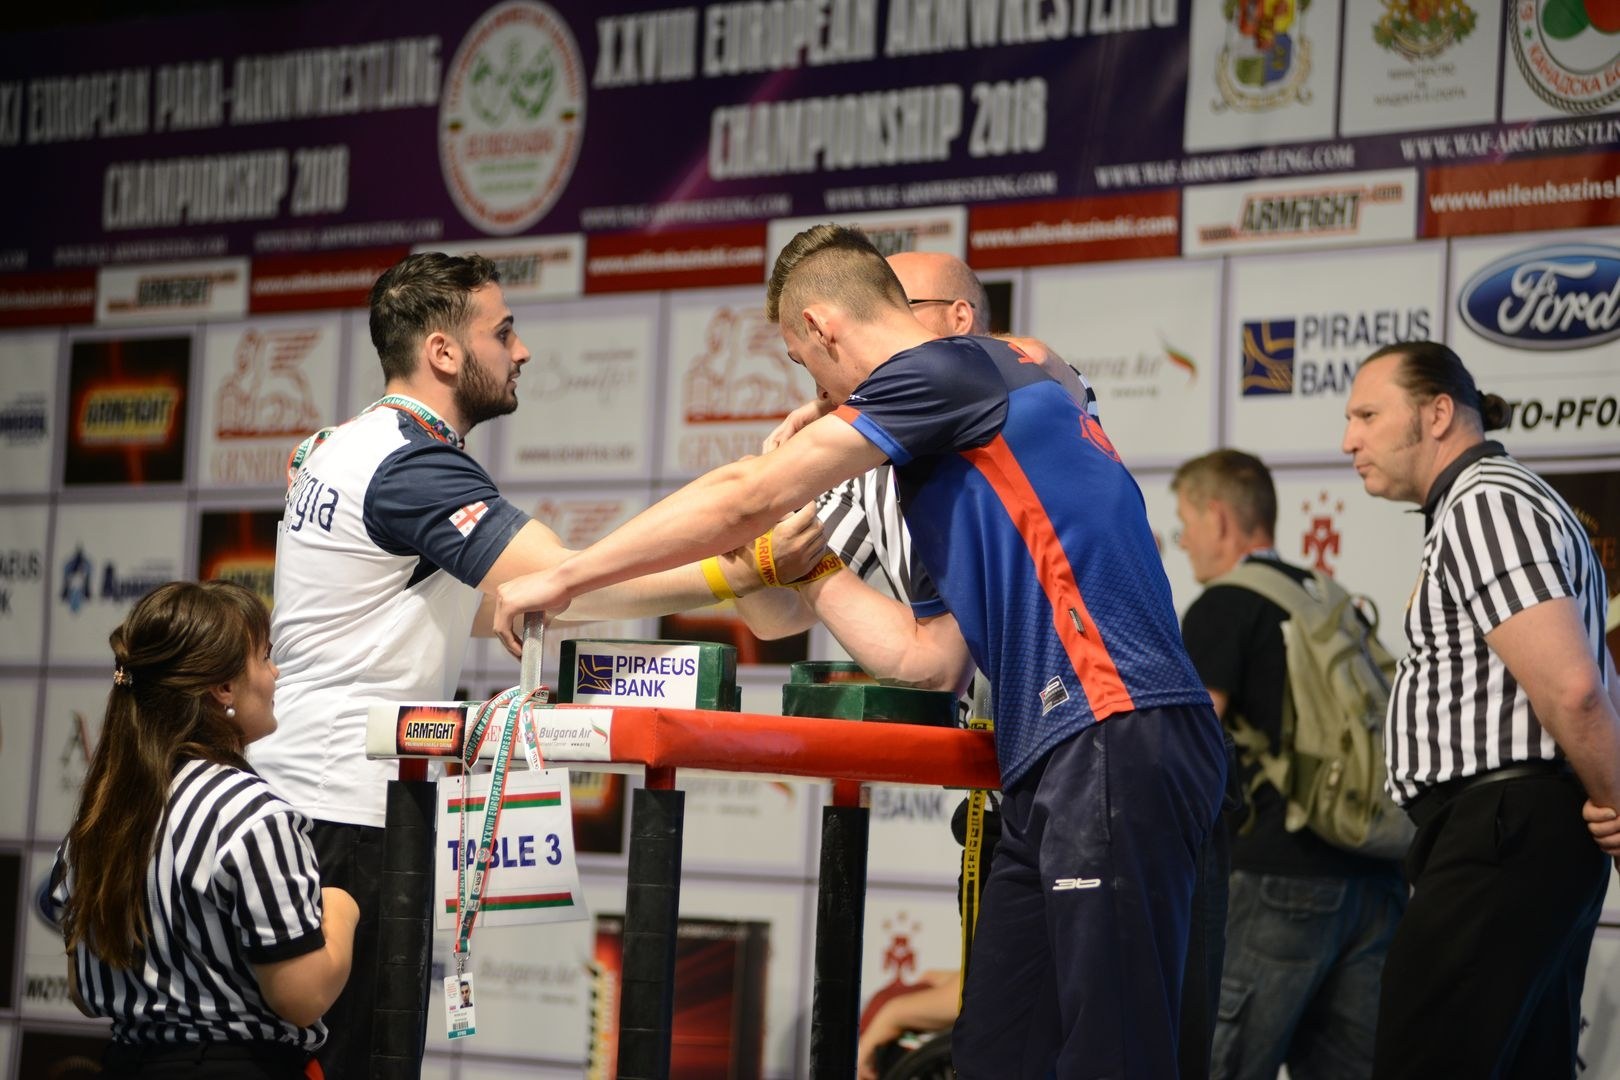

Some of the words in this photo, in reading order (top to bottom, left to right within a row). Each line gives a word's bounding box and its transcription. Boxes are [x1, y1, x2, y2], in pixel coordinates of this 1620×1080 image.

[593, 8, 697, 89] XXVIII
[703, 0, 877, 77] EUROPEAN
[26, 68, 149, 142] EUROPEAN
[154, 35, 440, 134] PARA-ARMWRESTLING
[708, 84, 963, 181] CHAMPIONSHIP
[968, 78, 1048, 157] 2018
[103, 148, 288, 232] CHAMPIONSHIP
[291, 145, 349, 216] 2018
[1241, 194, 1359, 234] ARMFIGHT
[1496, 260, 1620, 335] Ford
[1300, 309, 1431, 349] PIRAEUS
[1300, 359, 1358, 396] BAN
[1506, 397, 1620, 430] TO-PFO
[615, 655, 696, 677] PIRAEUS
[614, 678, 666, 698] BANK
[405, 722, 456, 740] ARMFIGHT
[539, 727, 577, 741] Bulgaria
[578, 728, 592, 739] Air
[447, 835, 536, 871] TABLE
[545, 833, 563, 866] 3
